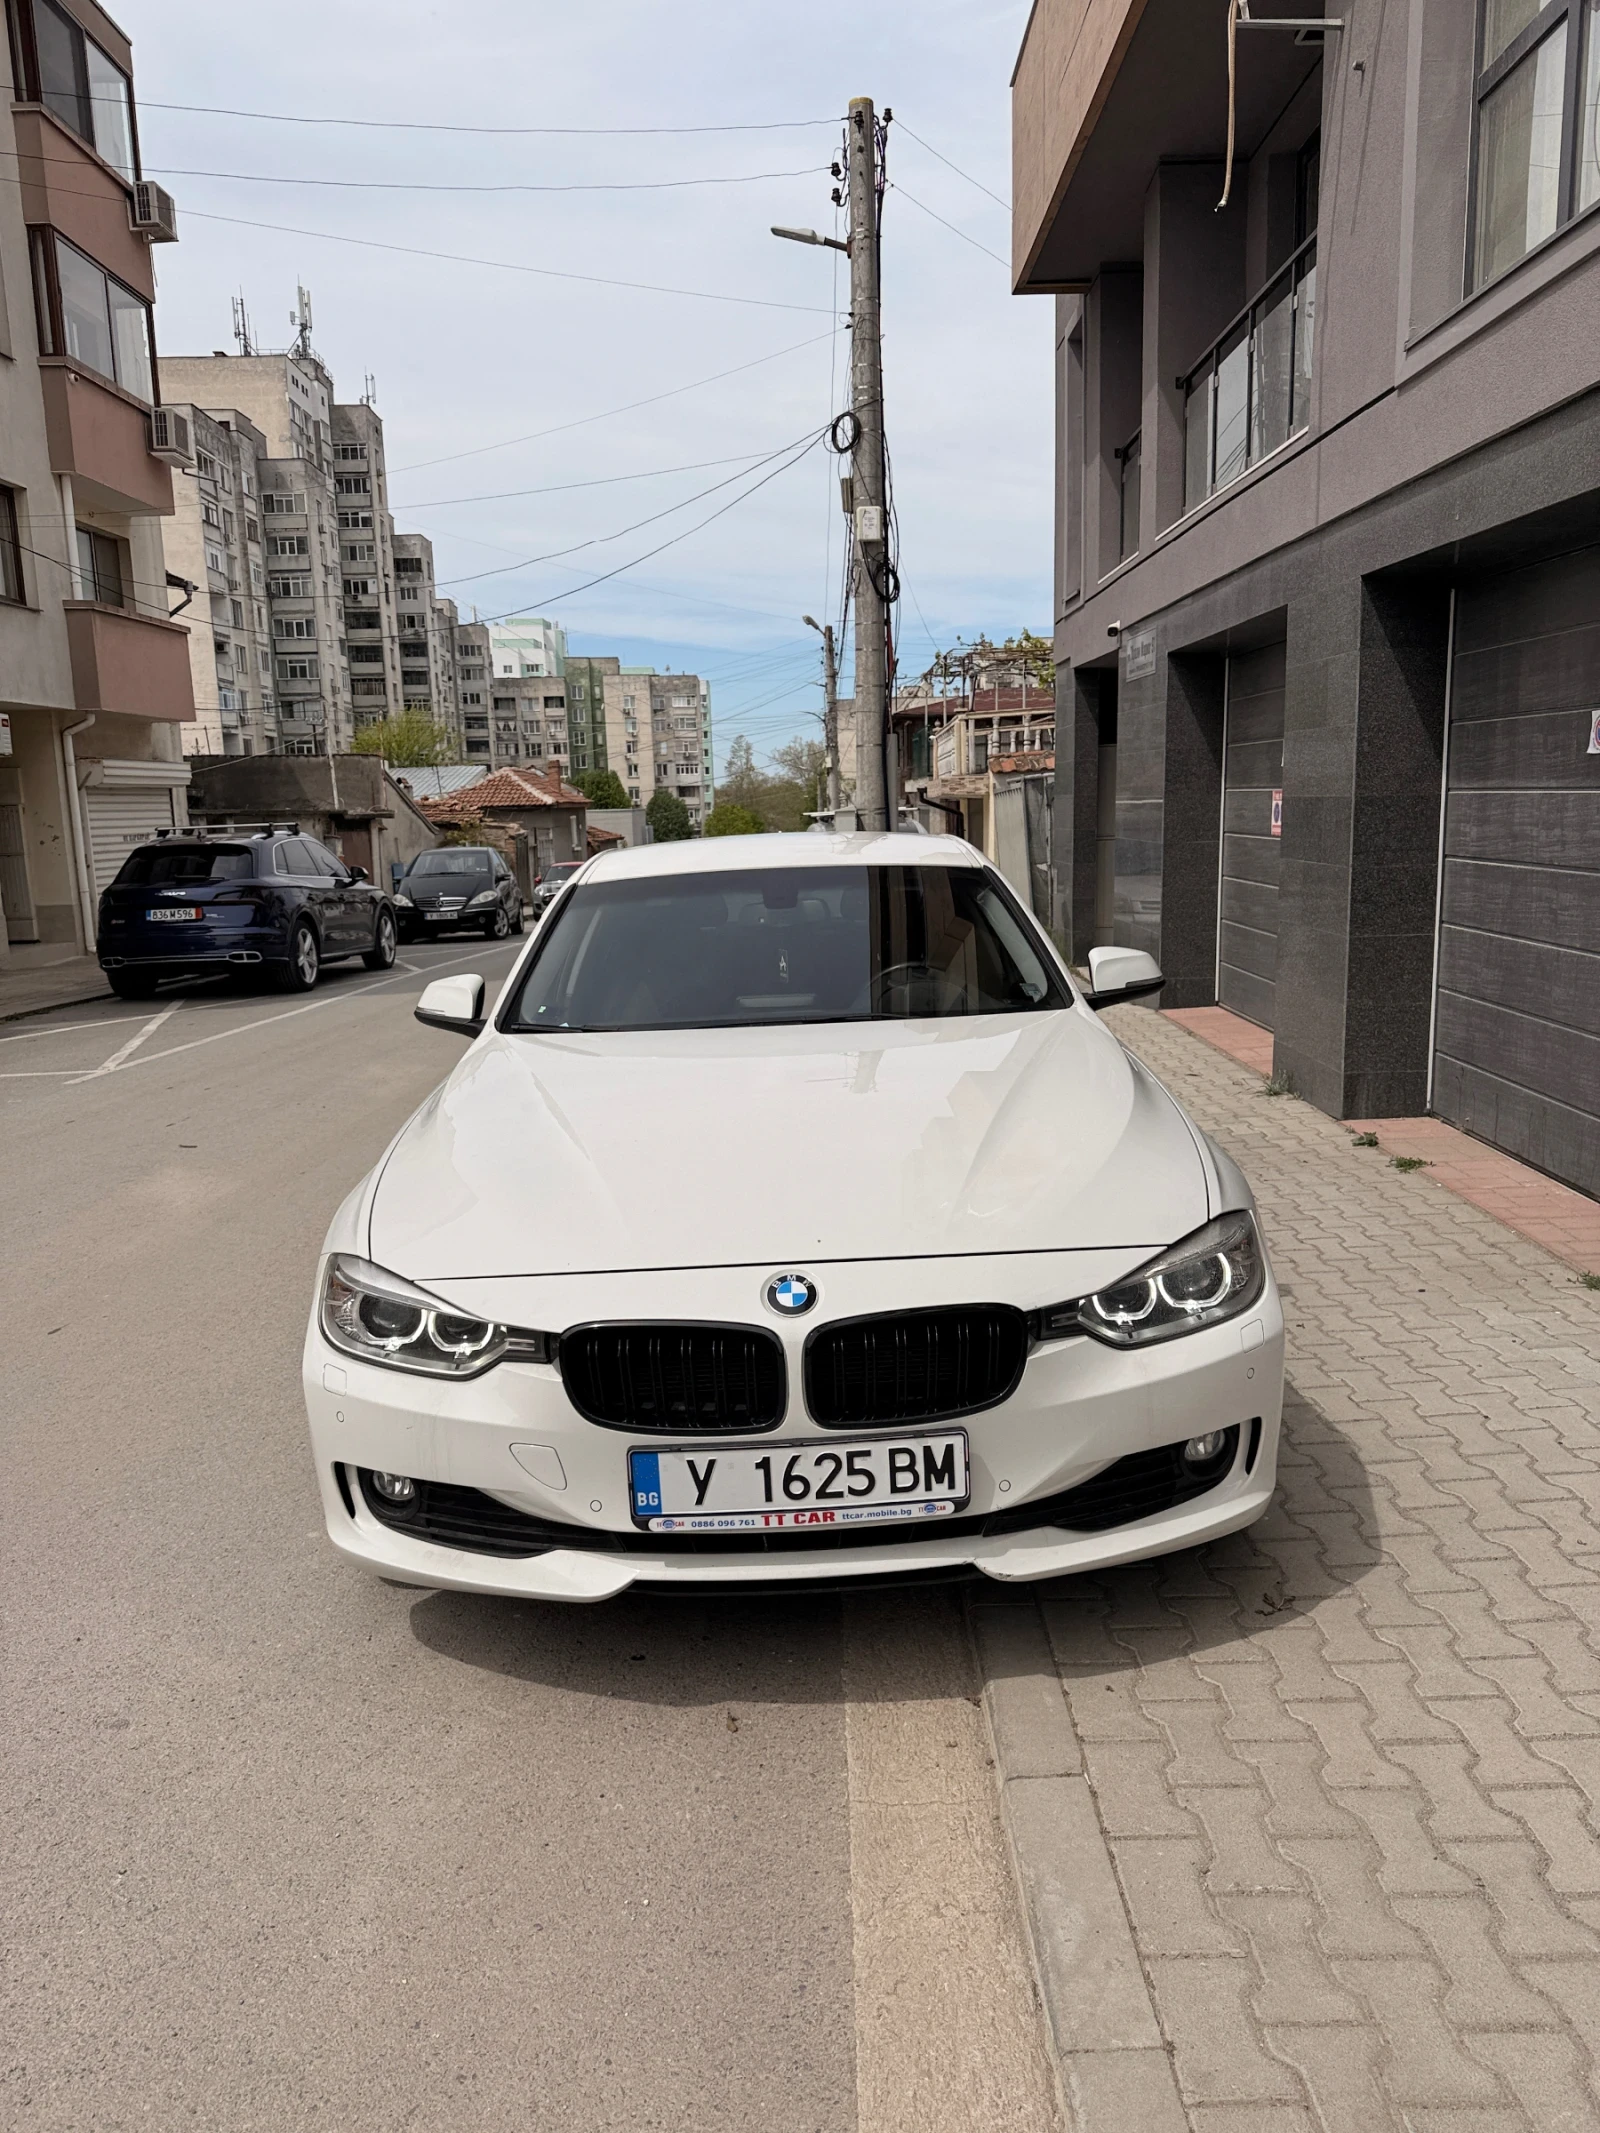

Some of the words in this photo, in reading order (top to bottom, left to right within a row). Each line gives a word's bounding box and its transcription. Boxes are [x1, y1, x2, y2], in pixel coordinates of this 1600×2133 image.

[772, 1275, 812, 1288] BMW
[754, 1449, 876, 1503] 1625
[888, 1443, 956, 1494] BM
[637, 1491, 659, 1507] BG
[761, 1514, 786, 1526] TT
[793, 1511, 836, 1525] CAR
[842, 1508, 912, 1520] ttcar.mobile.bg
[691, 1520, 715, 1528] 0886
[717, 1519, 735, 1527] 096
